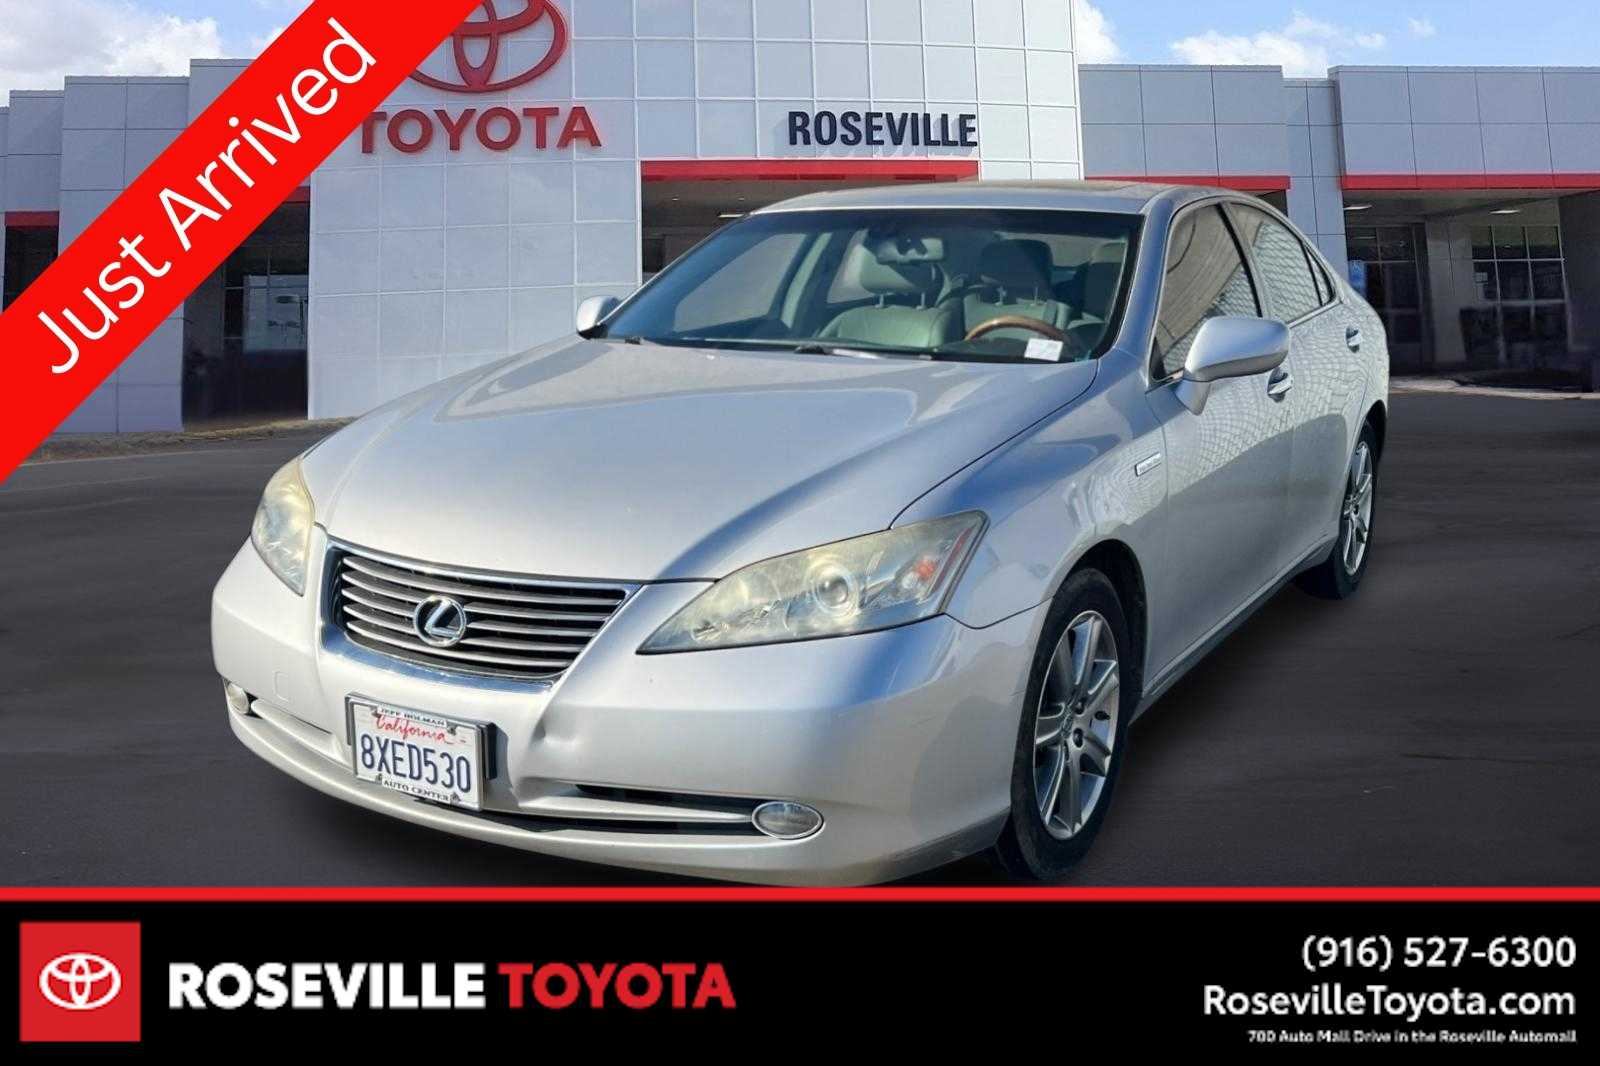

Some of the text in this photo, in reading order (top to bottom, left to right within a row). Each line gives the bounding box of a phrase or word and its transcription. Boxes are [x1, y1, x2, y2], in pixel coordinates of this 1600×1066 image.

[361, 106, 602, 154] TOYOTA
[788, 111, 978, 148] ROSEVILLE
[376, 714, 447, 741] California
[360, 733, 471, 793] 8XED530
[384, 779, 450, 802] AUTO CENTER
